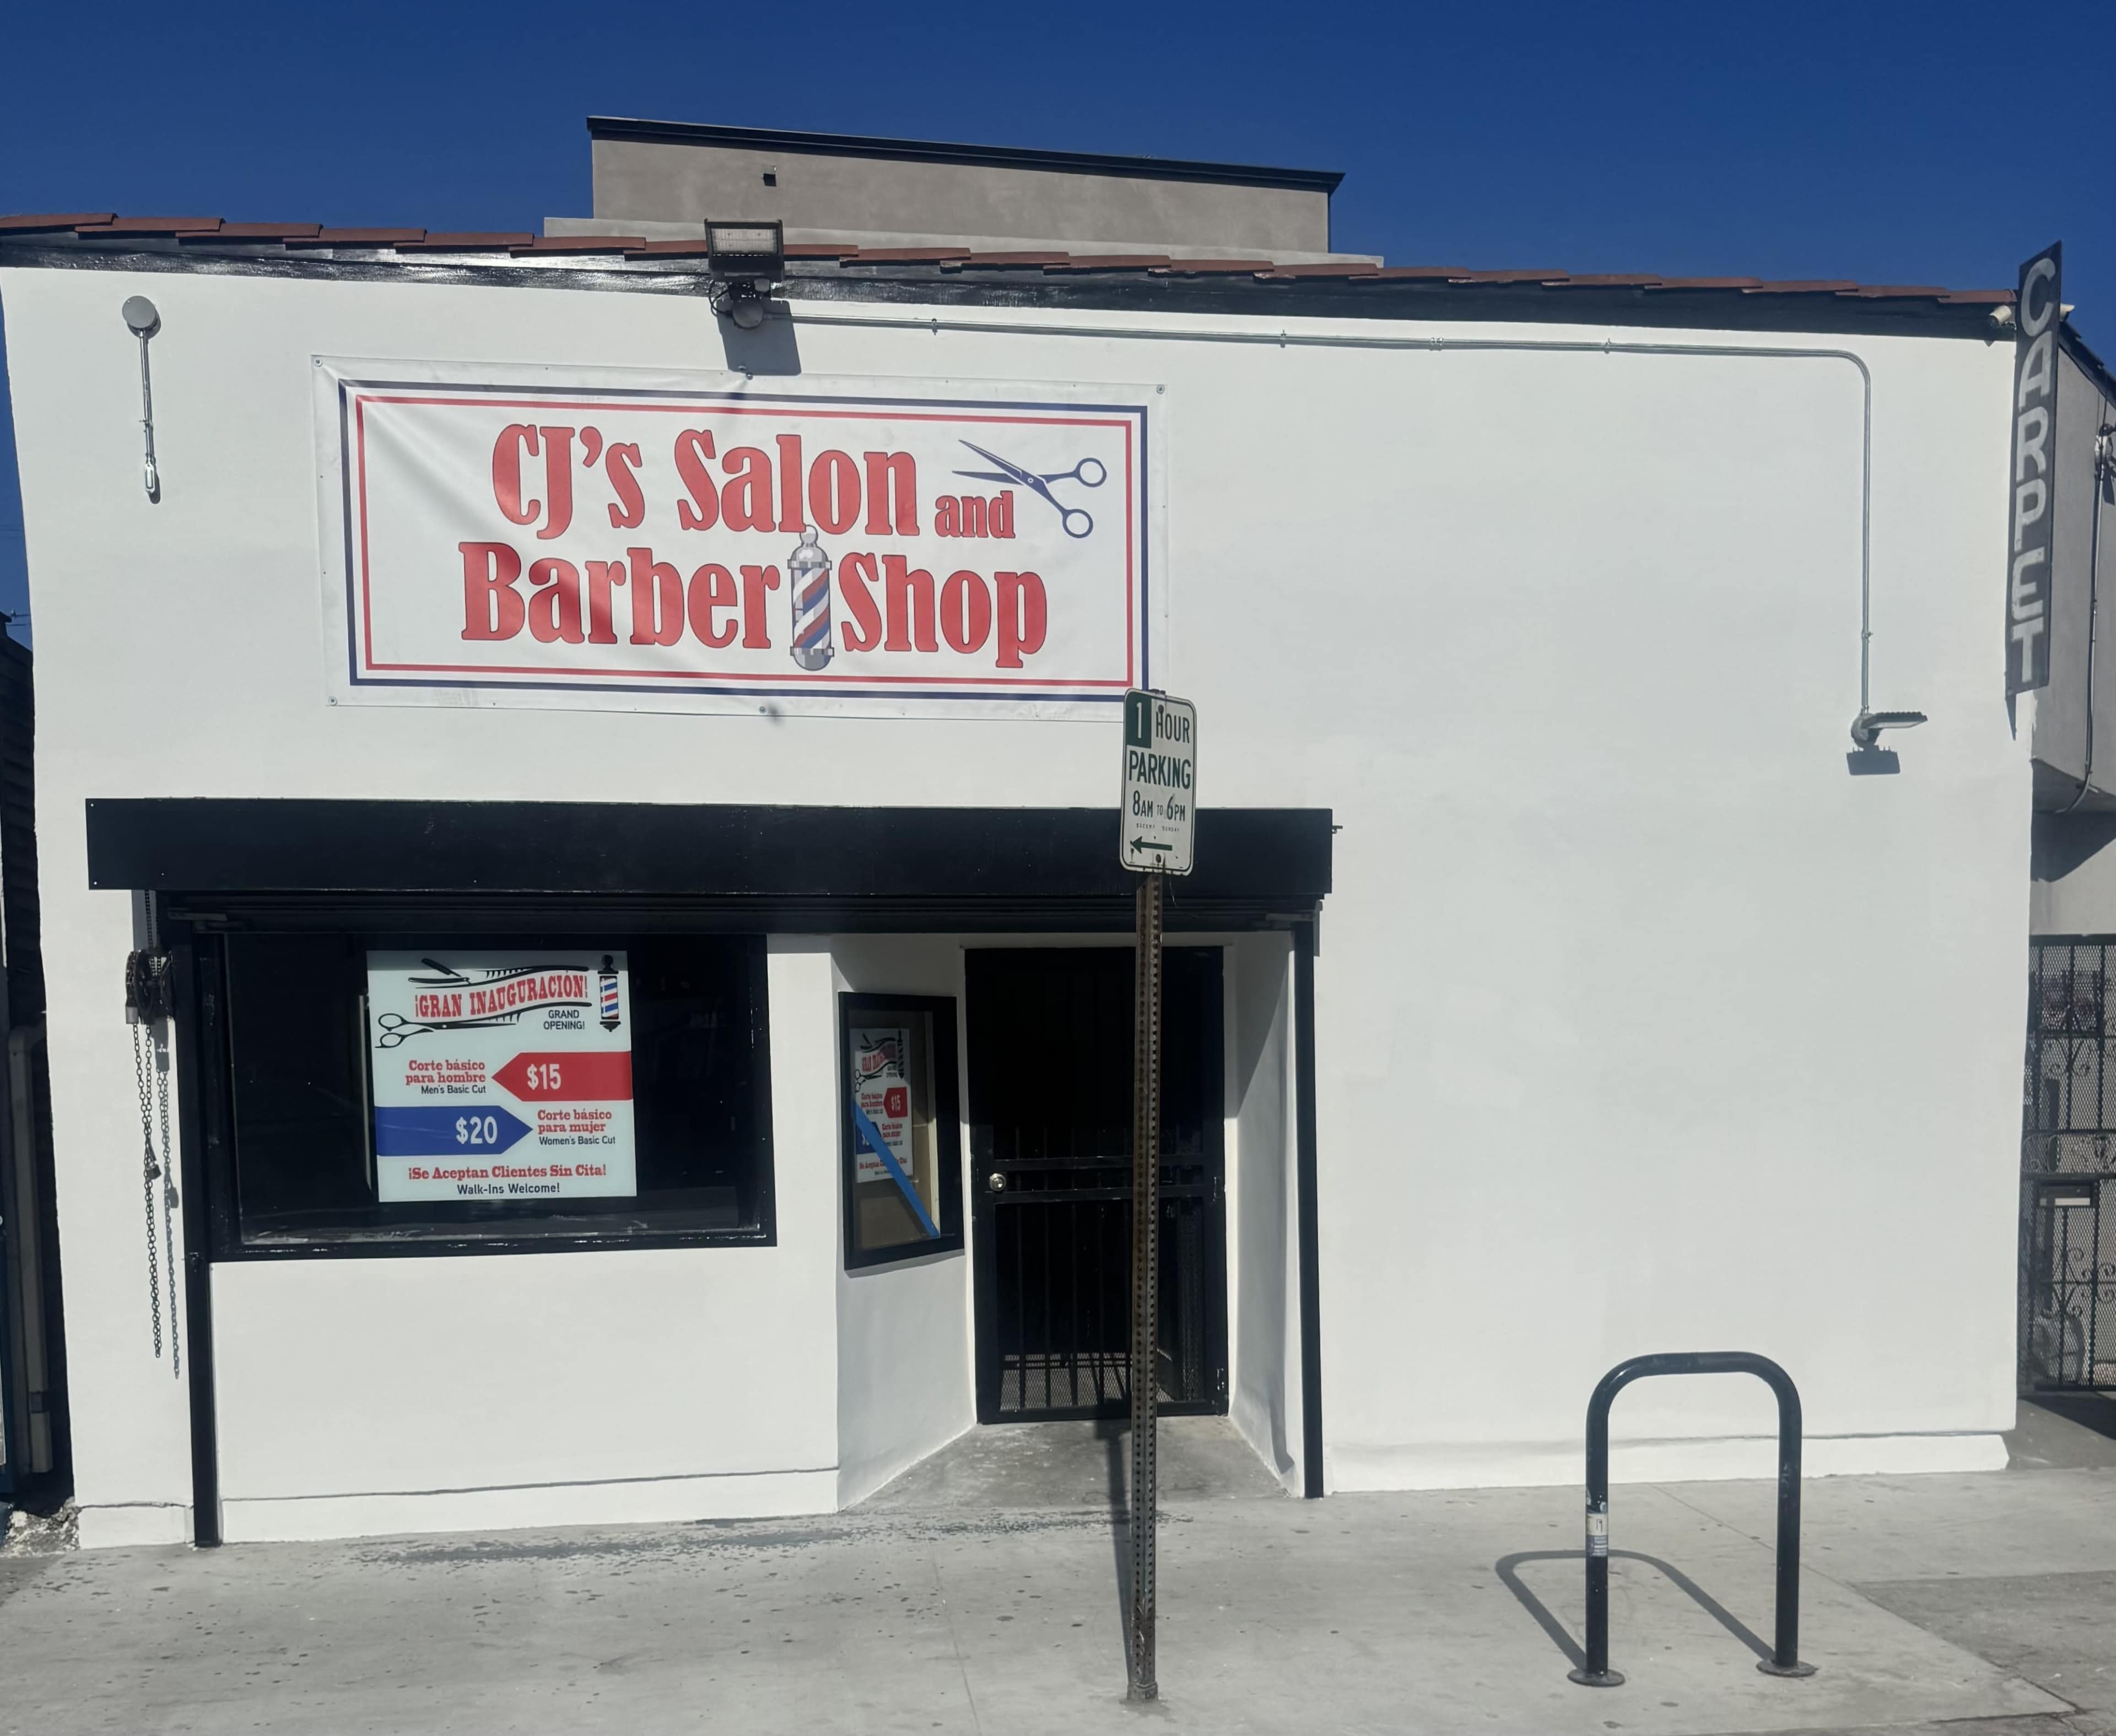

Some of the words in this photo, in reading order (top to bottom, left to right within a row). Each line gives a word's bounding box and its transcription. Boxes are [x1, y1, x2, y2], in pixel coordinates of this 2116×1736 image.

[2012, 257, 2056, 683] CARPET
[492, 424, 645, 540] CJ's
[673, 429, 920, 537] Salon
[935, 490, 1016, 540] and
[458, 542, 780, 650] Barber
[838, 552, 1048, 669] Shop
[1136, 702, 1142, 739] 1
[1156, 711, 1190, 744] HOUR
[1129, 750, 1191, 789] PARKING
[1133, 790, 1153, 818] 8AM
[1157, 804, 1163, 816] TO
[1167, 793, 1185, 822] 6PM
[548, 1010, 580, 1019] GRAND
[543, 1021, 585, 1030] OPENING!
[408, 1060, 443, 1071] Corte
[445, 1059, 485, 1071] básico
[406, 1074, 435, 1085] para
[438, 1072, 486, 1083] hombre
[527, 1063, 562, 1090] $15
[421, 1085, 445, 1094] Men's
[447, 1085, 469, 1094] Basic
[472, 1085, 486, 1094] Cut
[891, 1095, 901, 1111] $15
[537, 1109, 570, 1121] Corte
[573, 1108, 612, 1120] básico
[456, 1116, 498, 1144] $20
[538, 1123, 567, 1135] para
[569, 1121, 606, 1134] mujer
[539, 1136, 576, 1145] Women's
[578, 1135, 600, 1145] Basic
[602, 1135, 616, 1144] Cut
[408, 1167, 429, 1180] ¡Se
[432, 1166, 489, 1181] Aceptan
[491, 1165, 548, 1178] Clientes
[549, 1164, 573, 1177] Sin
[575, 1164, 607, 1177] Cita!
[457, 1184, 505, 1194] Walk-Ins
[508, 1182, 560, 1194] Welcome!
